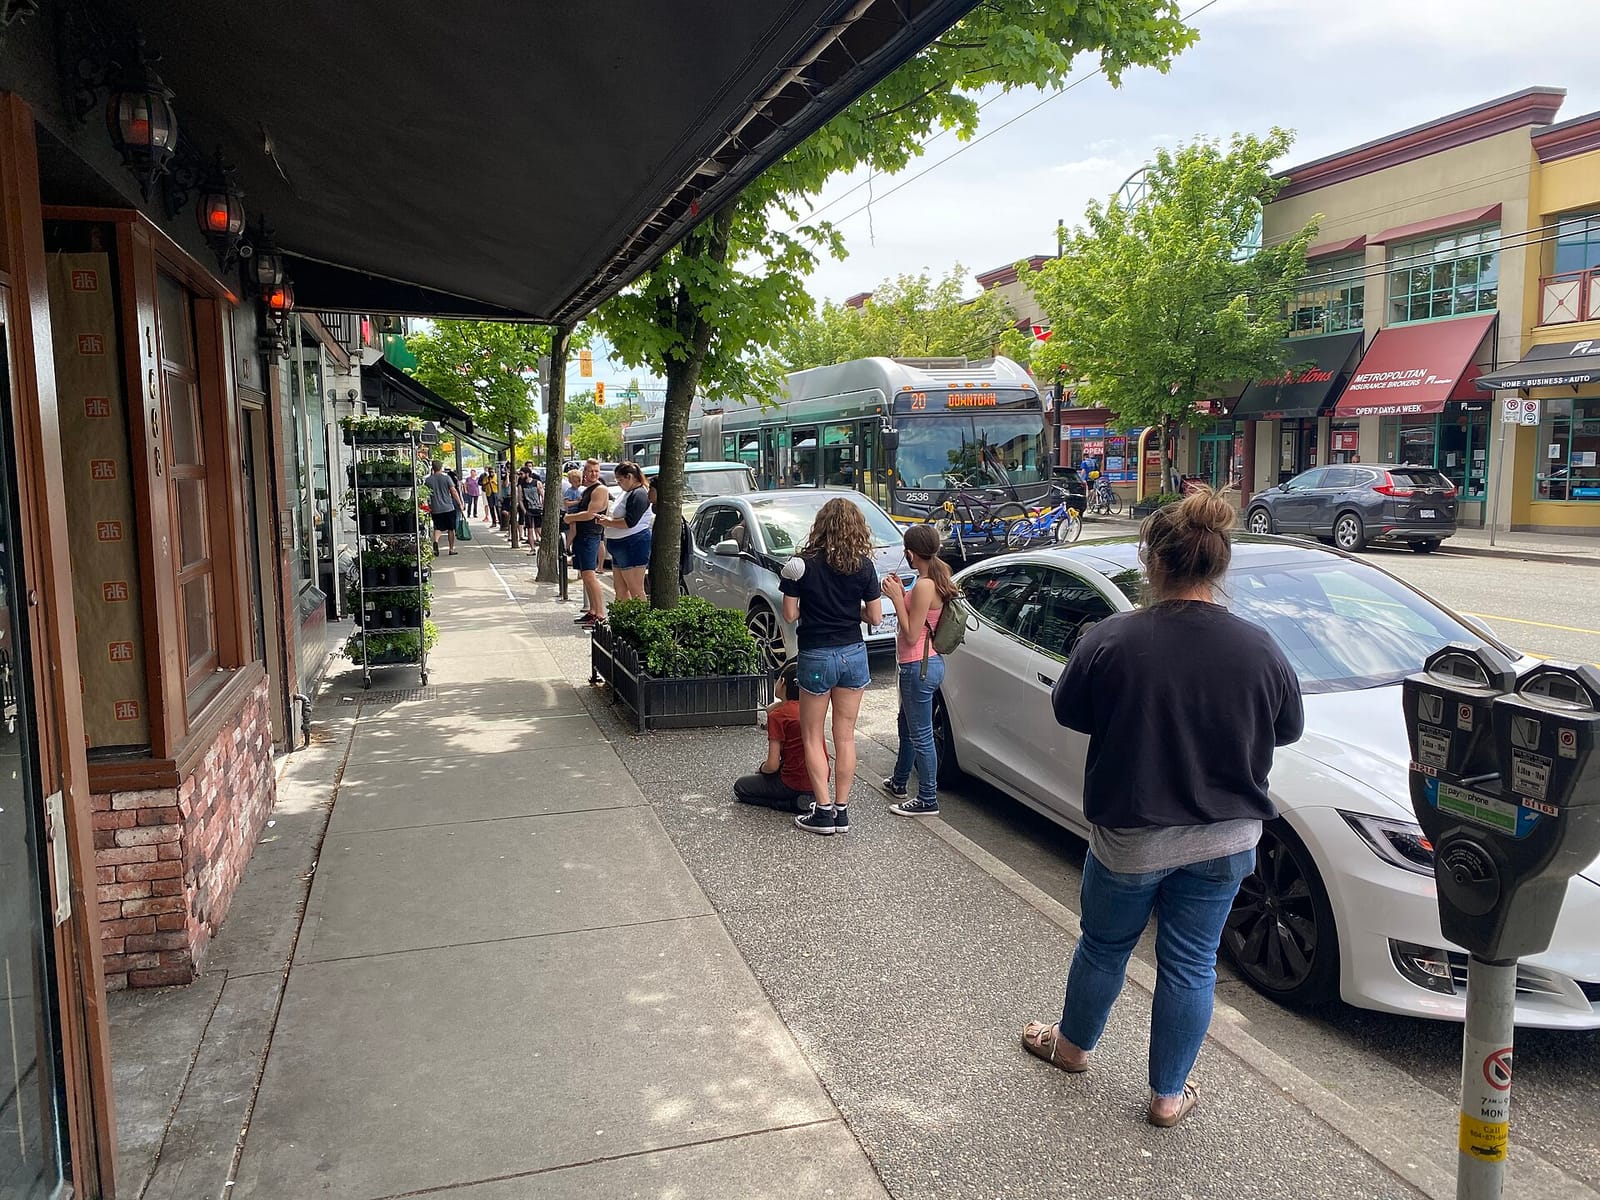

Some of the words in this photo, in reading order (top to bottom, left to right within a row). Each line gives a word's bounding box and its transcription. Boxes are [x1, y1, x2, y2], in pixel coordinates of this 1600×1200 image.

[1354, 368, 1428, 383] METROPOLITAN
[1501, 380, 1522, 388] HOME
[1527, 377, 1563, 386] BUSINESS
[1568, 375, 1590, 383] AUTO
[1349, 382, 1387, 391] INSURANCE
[1386, 379, 1422, 389] BROKERS
[911, 392, 927, 410] 20
[948, 392, 997, 407] DOWNTOWN
[1356, 407, 1373, 415] OPEN
[1379, 406, 1396, 414] DAYS
[1401, 404, 1422, 413] WEEK
[906, 492, 929, 501] 2536
